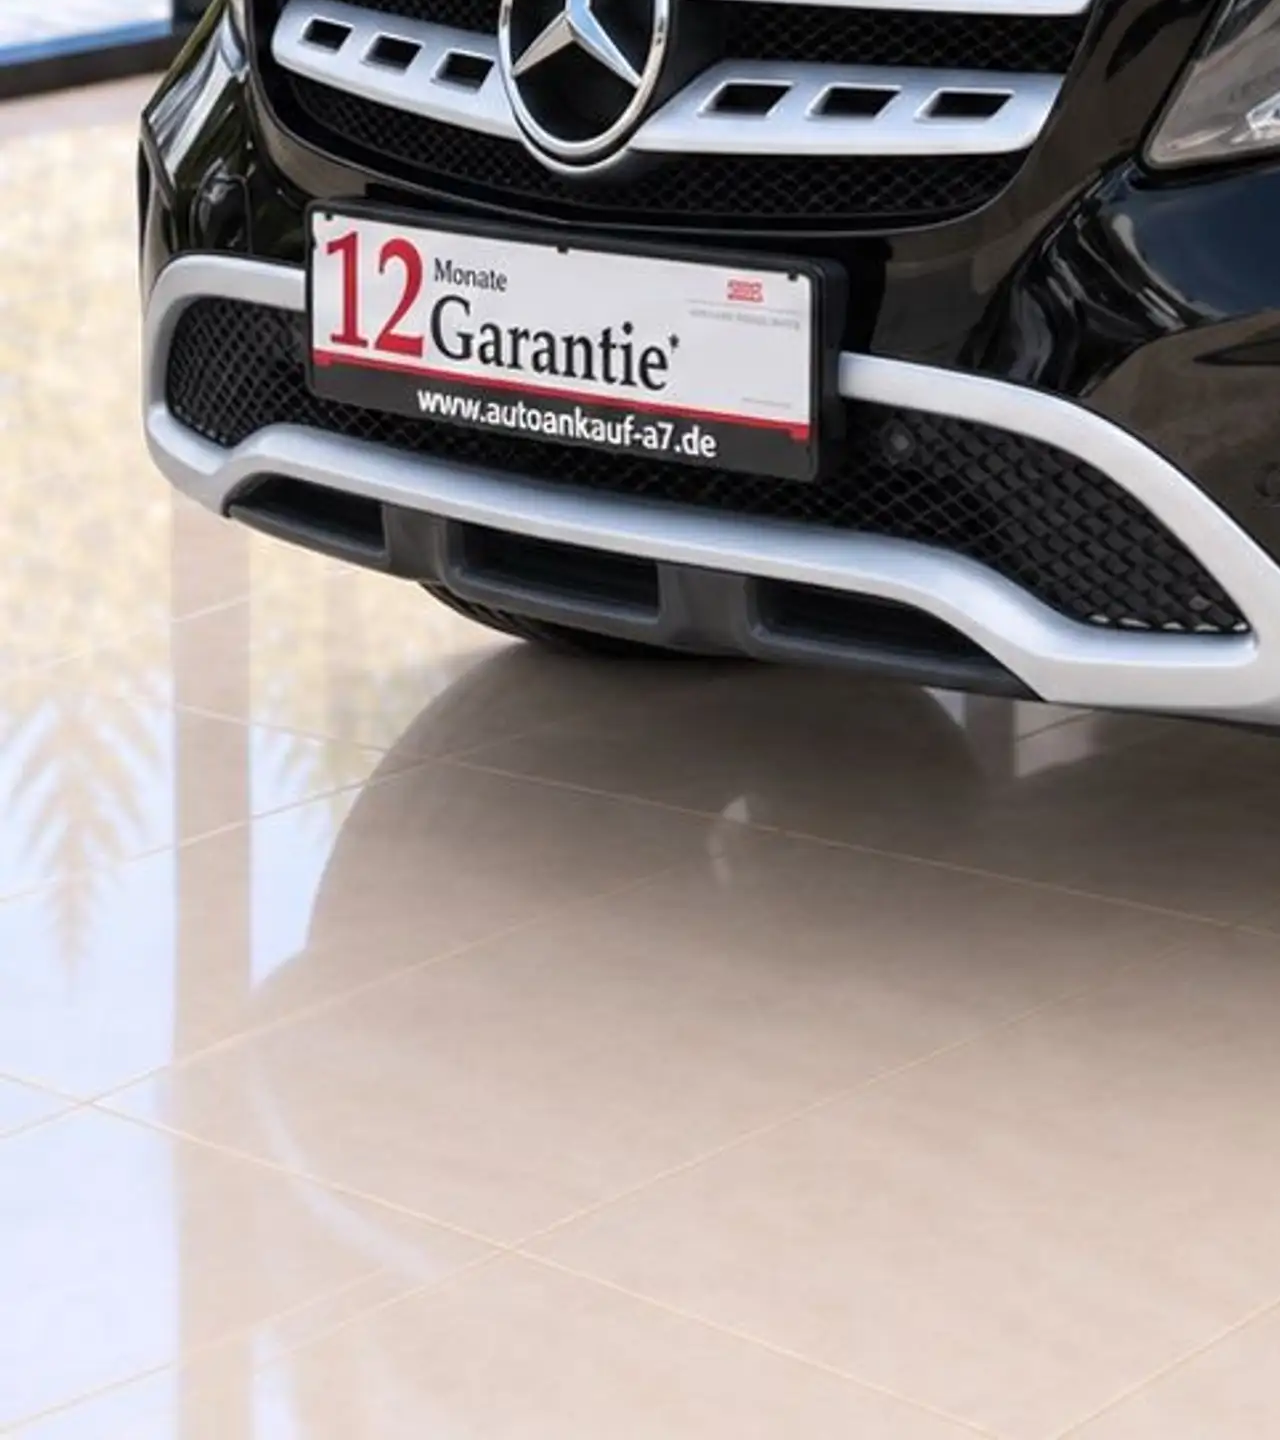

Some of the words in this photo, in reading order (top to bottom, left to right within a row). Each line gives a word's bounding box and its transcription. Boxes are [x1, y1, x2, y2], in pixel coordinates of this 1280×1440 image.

[326, 230, 424, 357] 12
[434, 257, 508, 292] Monate
[418, 388, 717, 457] www.autoankauf-a7.de
